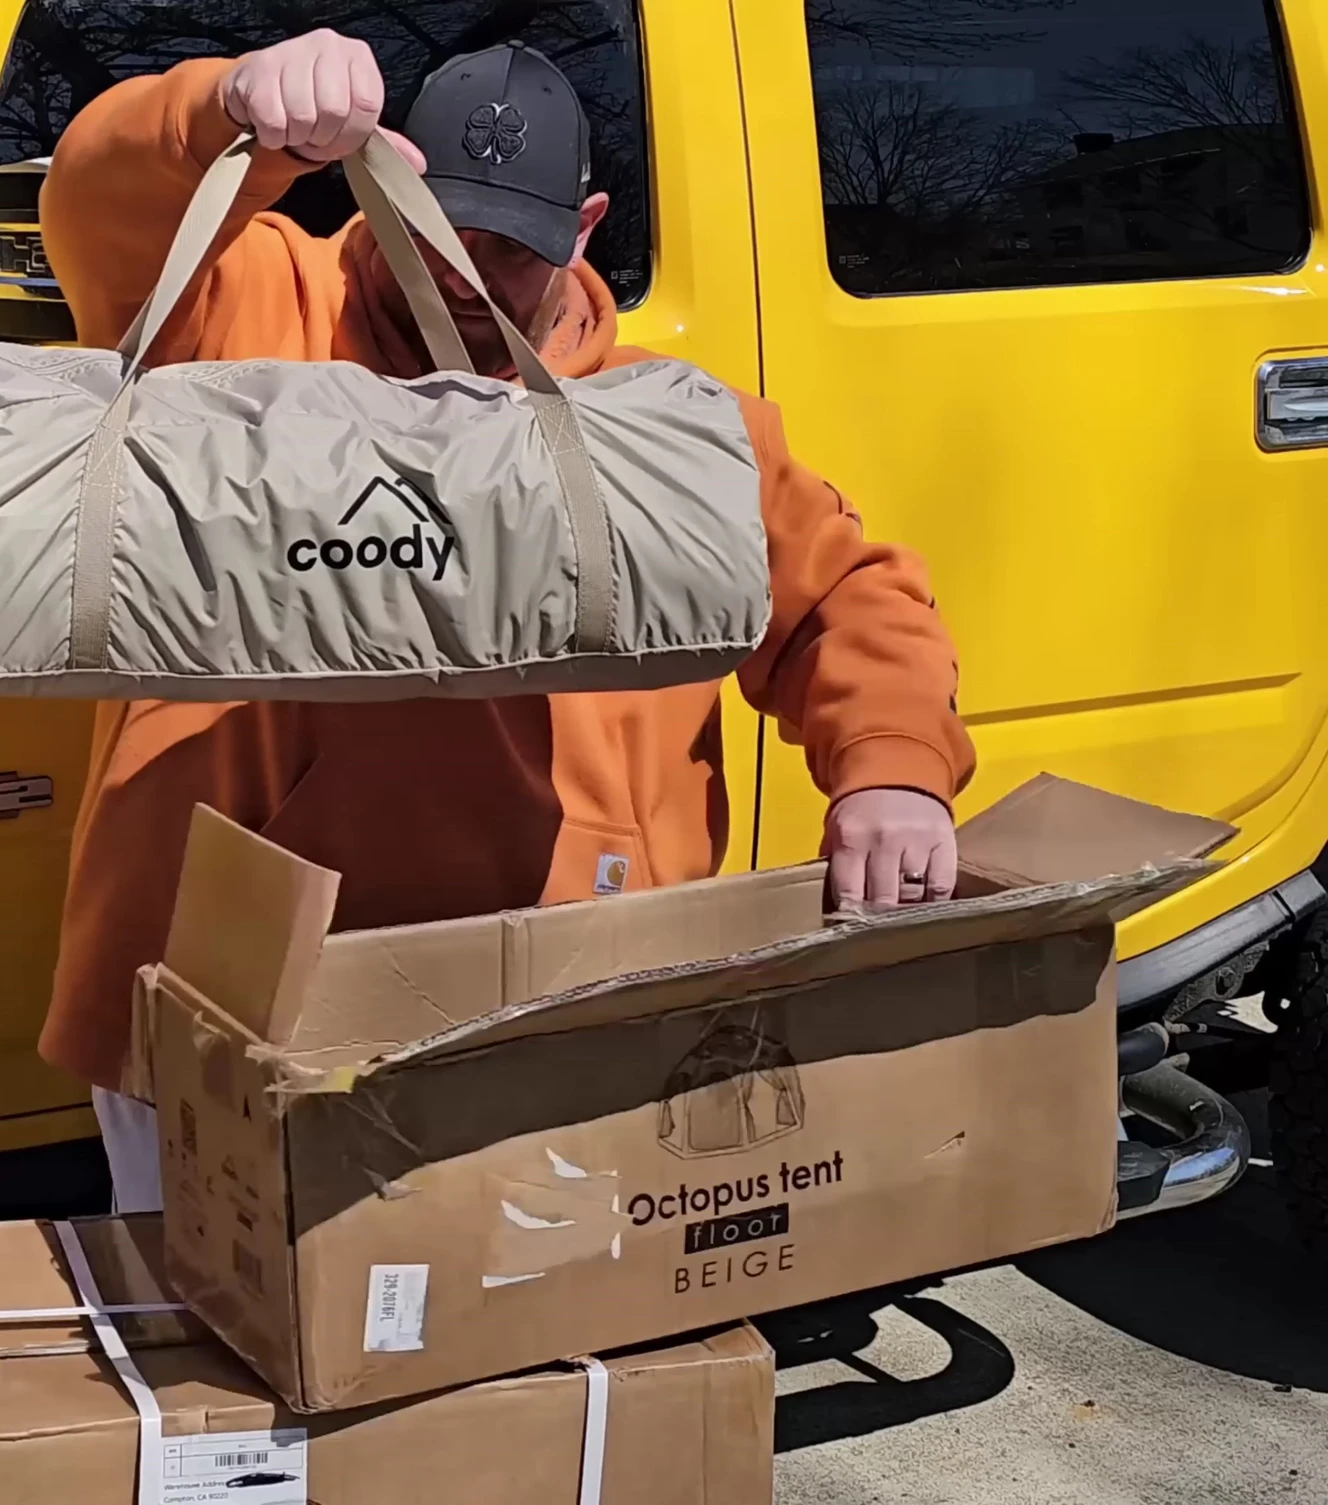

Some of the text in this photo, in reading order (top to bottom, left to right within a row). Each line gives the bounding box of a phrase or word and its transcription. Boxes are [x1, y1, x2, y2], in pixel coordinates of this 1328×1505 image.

[287, 524, 455, 581] coody
[627, 1150, 844, 1226] Octopus tent
[674, 1244, 795, 1294] BEIGE
